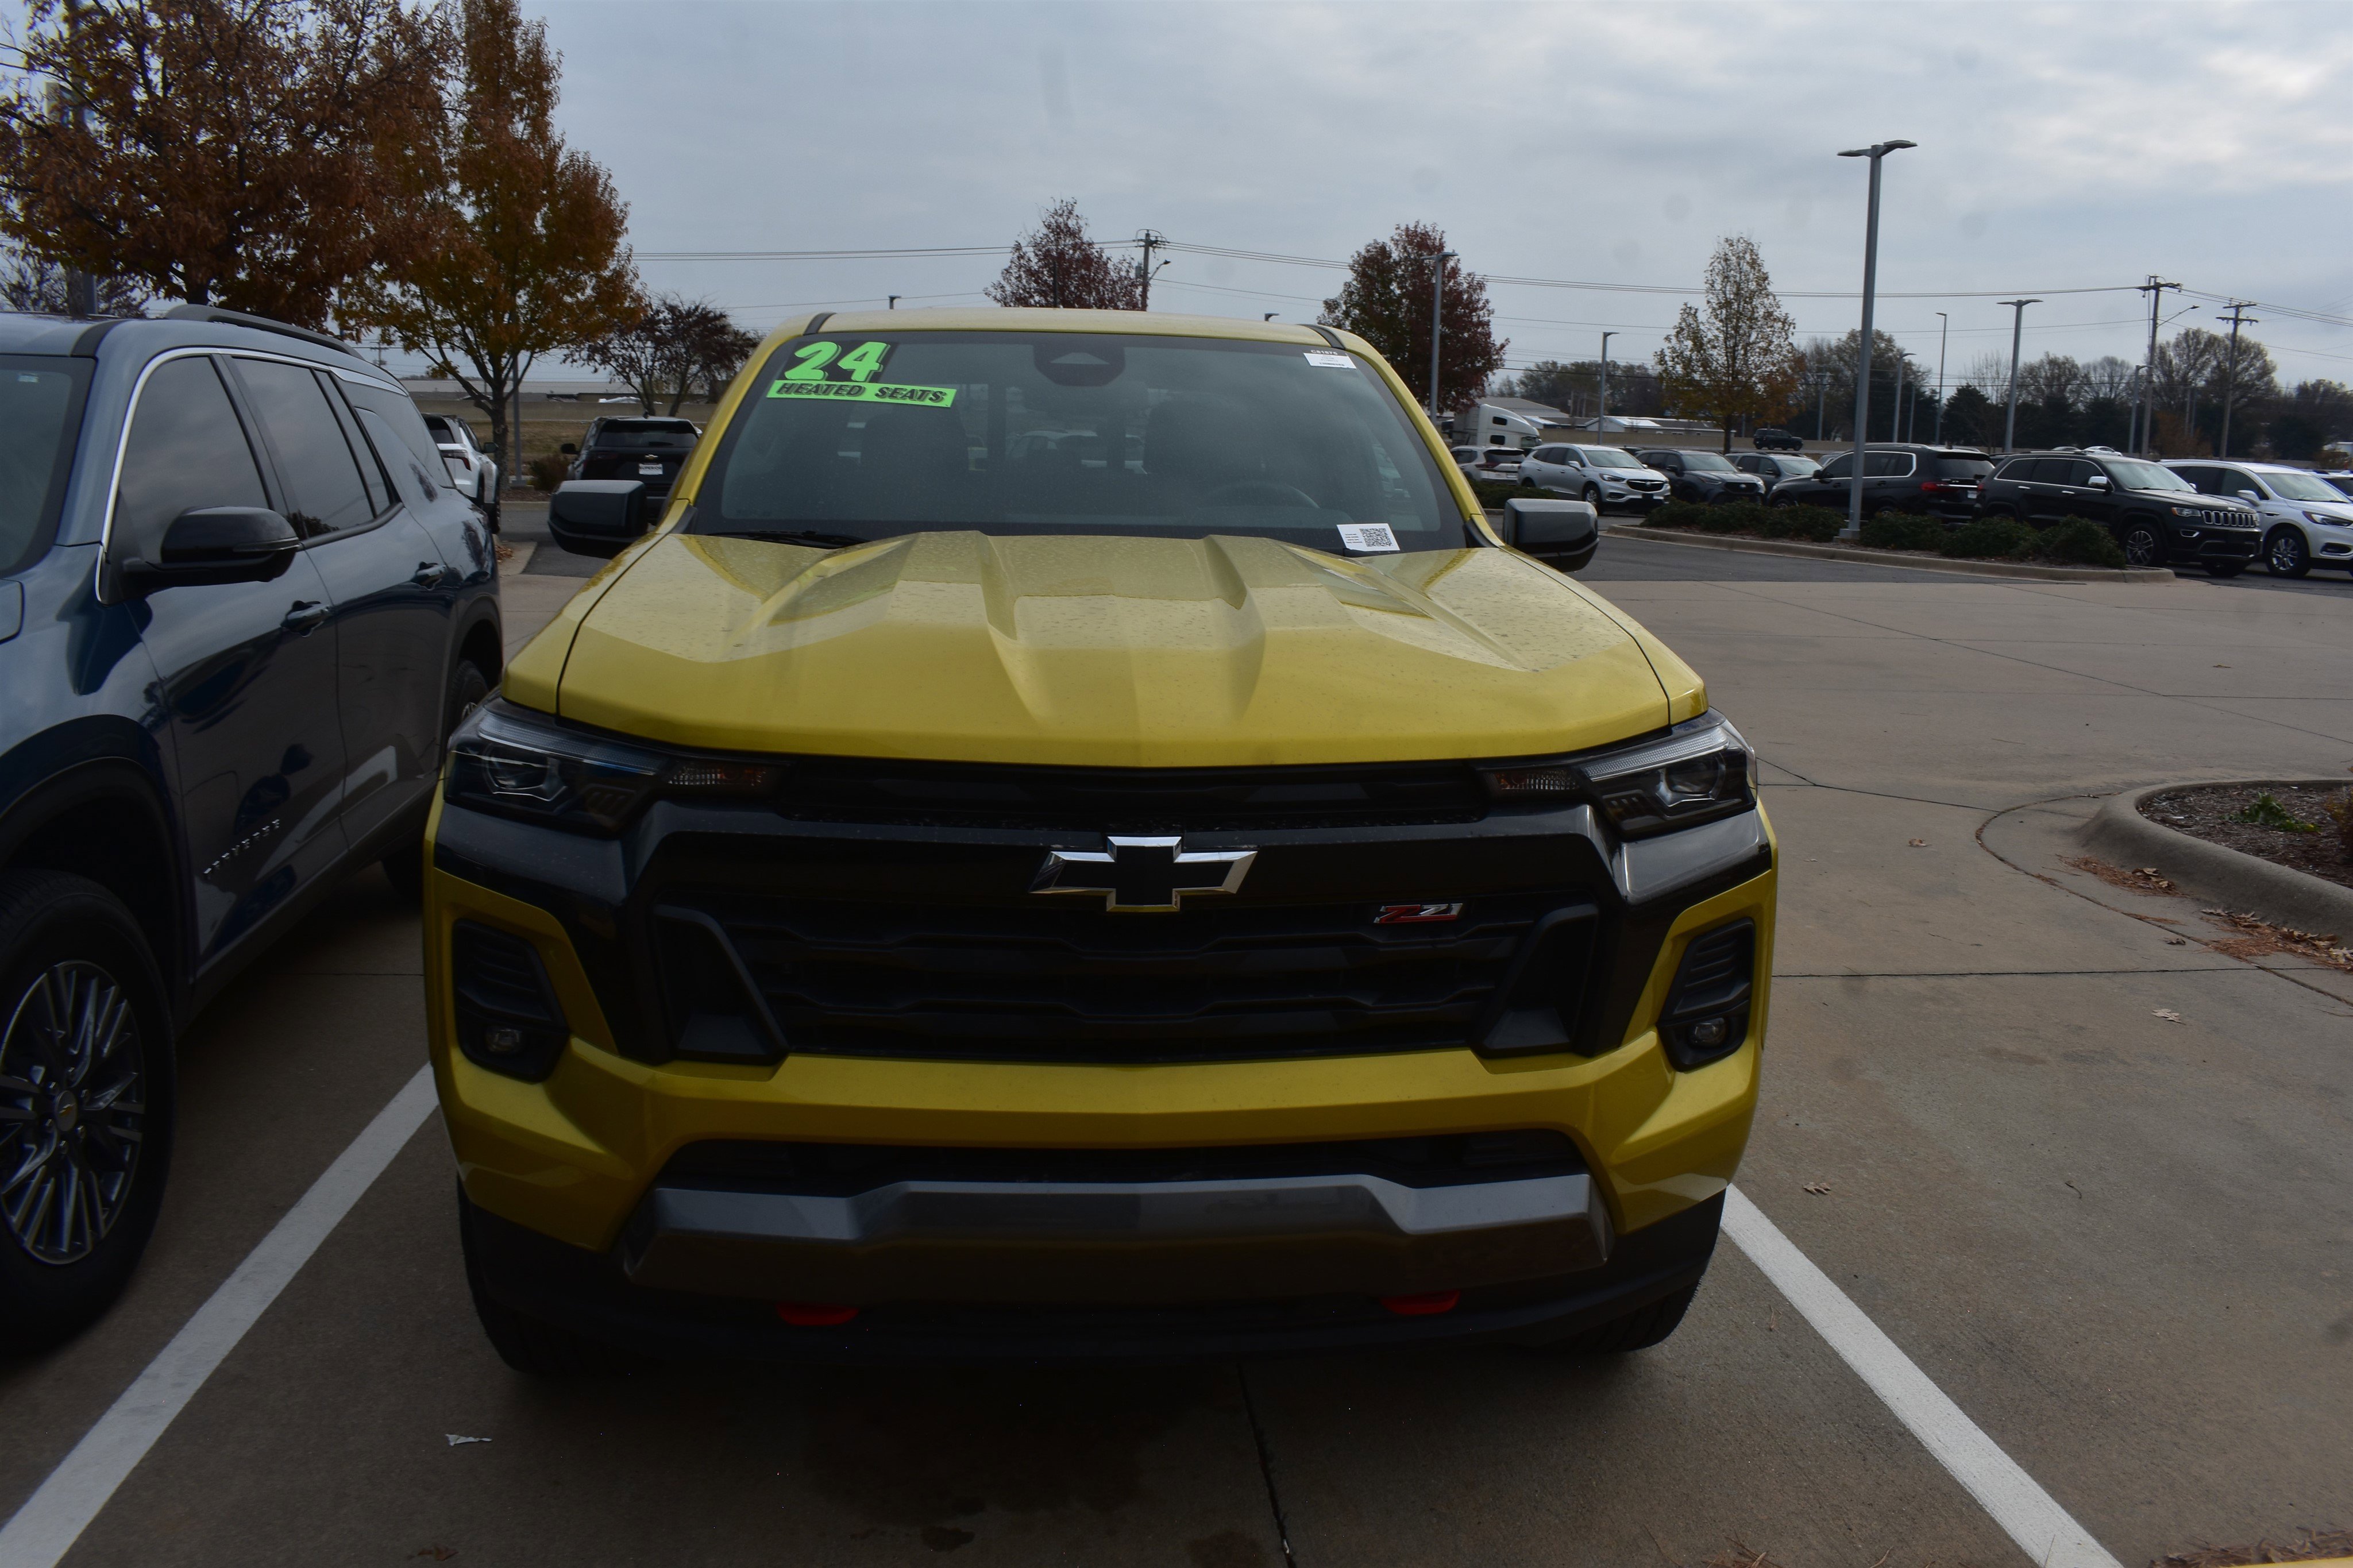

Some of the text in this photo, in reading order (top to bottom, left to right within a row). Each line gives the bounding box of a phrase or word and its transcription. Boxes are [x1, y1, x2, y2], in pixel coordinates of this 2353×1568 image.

[784, 341, 890, 383] 24
[776, 383, 947, 403] HEATED SEATS
[1374, 903, 1463, 924] Z71
